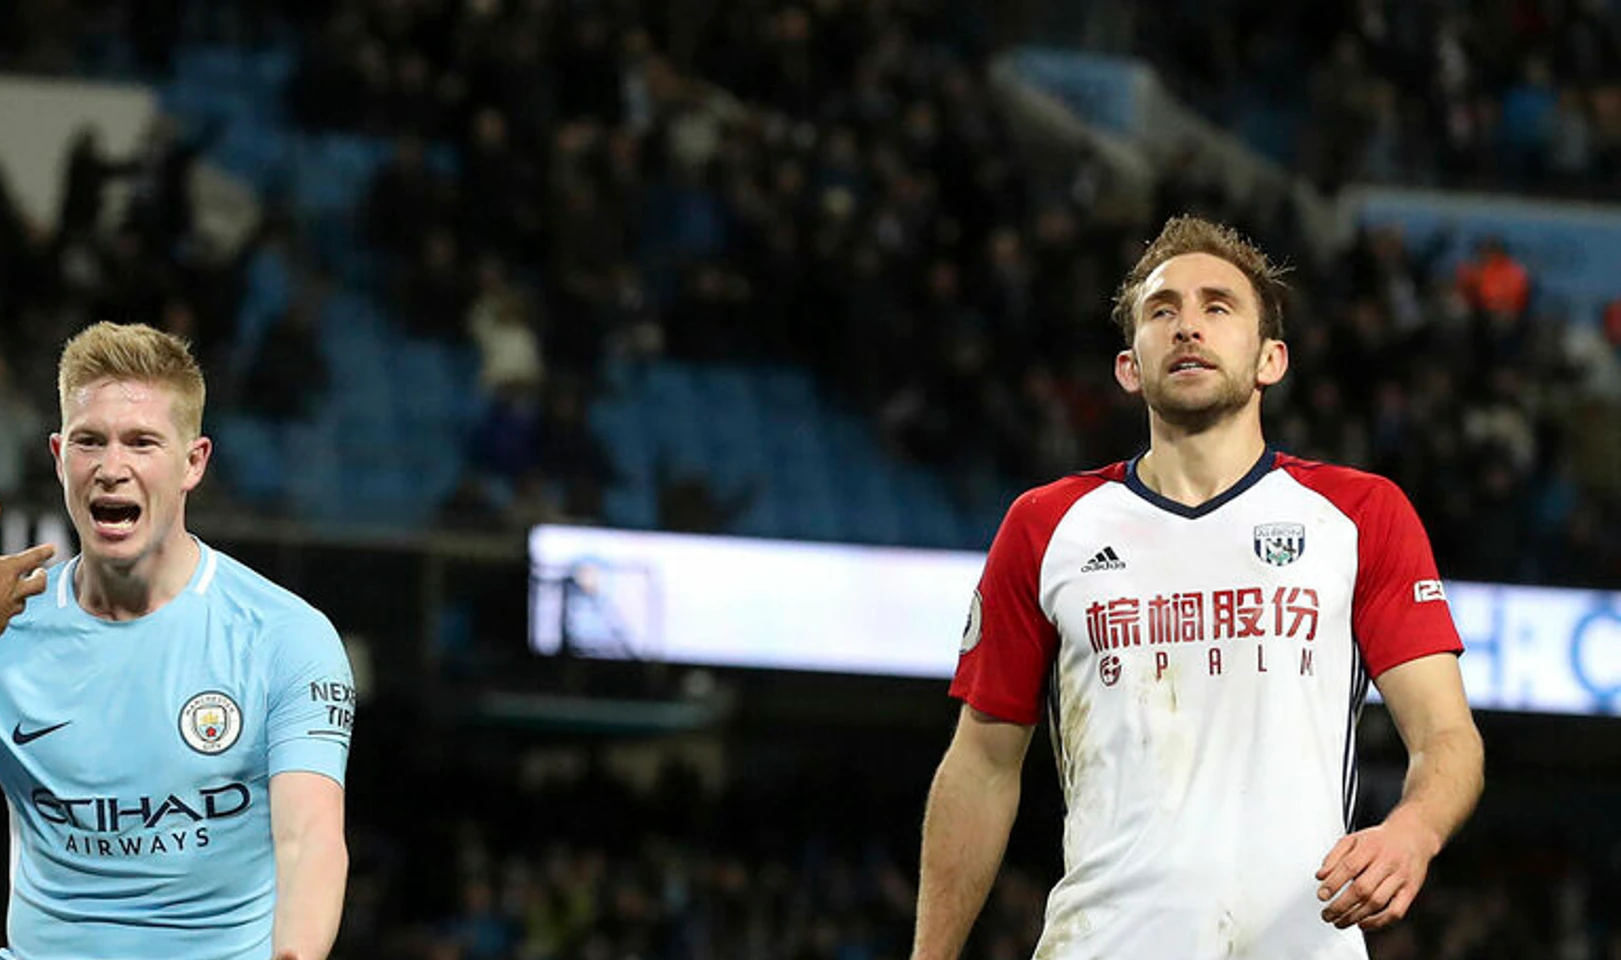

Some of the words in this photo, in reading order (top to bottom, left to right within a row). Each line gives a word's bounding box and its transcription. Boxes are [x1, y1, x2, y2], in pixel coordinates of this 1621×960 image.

[1085, 586, 1321, 654] 棕榈股份
[1155, 644, 1315, 682] PALM
[32, 782, 251, 833] ETIHAD
[65, 826, 210, 856] AIRWAYS
